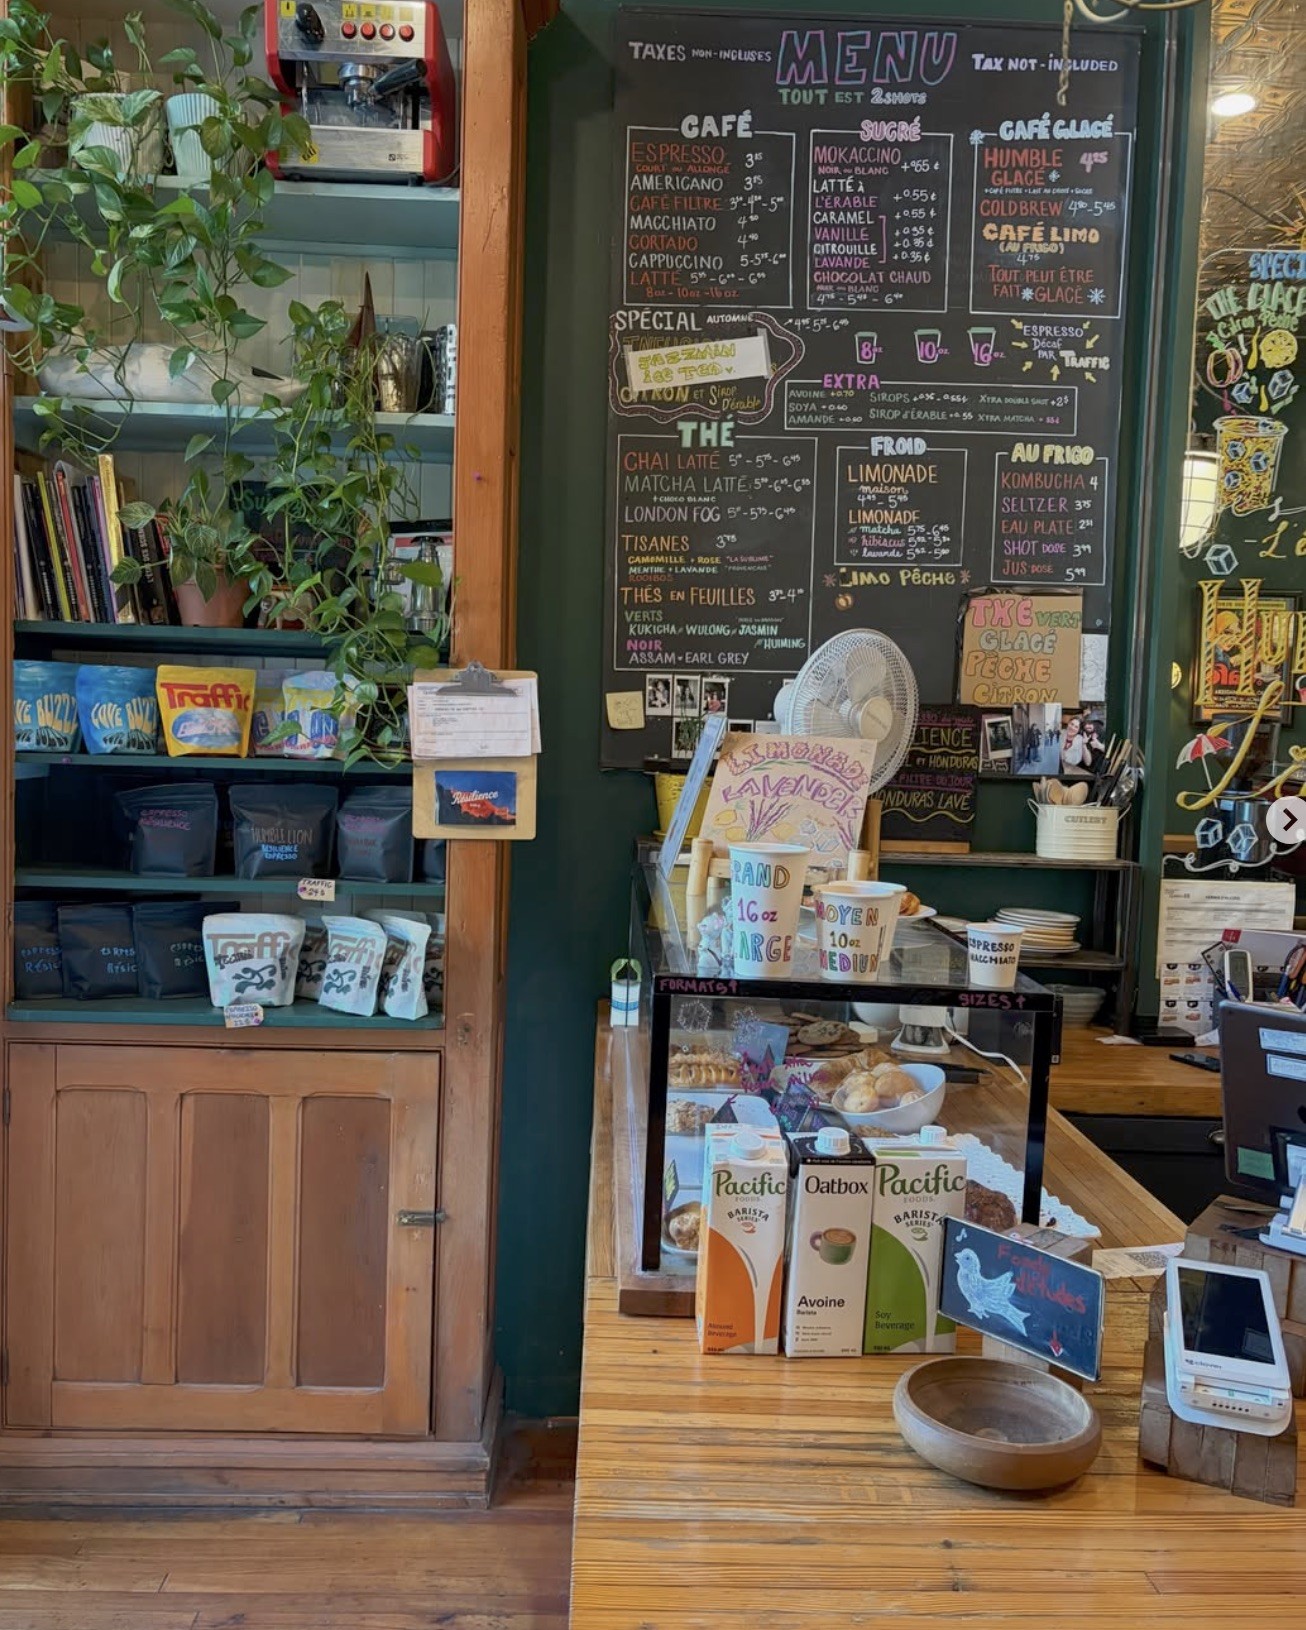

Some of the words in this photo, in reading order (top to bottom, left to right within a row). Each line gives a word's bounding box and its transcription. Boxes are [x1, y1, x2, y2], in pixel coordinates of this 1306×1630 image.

[629, 41, 686, 61] TAXES
[776, 30, 957, 85] MENU
[972, 53, 1003, 71] TAX
[778, 88, 828, 105] TOUT
[835, 91, 865, 103] EST
[680, 109, 752, 139] CAFÉ
[860, 115, 921, 142] SUCRÉ
[999, 112, 1050, 141] CAFÉ
[1052, 113, 1114, 140] GLACÉ
[631, 142, 725, 165] ESPRESSO
[814, 146, 901, 165] MOKACCINO
[984, 148, 1064, 169] HUMBLE
[630, 174, 724, 192] AMERICANO
[813, 176, 855, 193] LATTÉ
[991, 167, 1045, 187] GLACÉ
[630, 194, 669, 212] CAFÉ
[674, 197, 721, 211] FILTRE
[630, 215, 716, 231] MACCHIATO
[813, 211, 875, 225] CARAMEL
[814, 227, 869, 241] VANILLE
[982, 221, 1045, 241] CAFÉ
[1050, 226, 1100, 244] LIMO
[629, 233, 698, 251] CORTADO
[813, 243, 878, 255] CITROUILLE
[628, 253, 723, 270] CAPPUCCINO
[814, 256, 871, 269] LAVANDE
[813, 271, 884, 284] CHOCOLAT
[889, 271, 932, 284] CHAUD
[1026, 268, 1054, 283] PEUT
[993, 284, 1022, 298] FAIT
[1034, 285, 1084, 304] GLACÉ
[615, 307, 703, 331] SPÉCIAL
[1023, 325, 1084, 338] ESPRESSO
[823, 374, 881, 390] EXTRA
[788, 389, 826, 399] AVOINE
[870, 392, 910, 403] SIROPS
[788, 402, 817, 412] SOYA
[869, 408, 901, 420] SIROP
[788, 414, 836, 424] AMANDE
[677, 414, 735, 448] THÉ
[870, 436, 927, 457] FROID
[1011, 442, 1040, 463] AU
[1042, 444, 1095, 466] FRIGO
[624, 451, 669, 471] CHAI
[677, 451, 720, 470] LATTÉ
[847, 464, 938, 484] LIMONADE
[1001, 472, 1085, 490] KOMBUCHA
[624, 475, 696, 492] MATCHA
[859, 485, 909, 495] maison
[1001, 497, 1069, 513] SELTZER
[624, 506, 688, 523] LONDON
[693, 506, 721, 522] FOG
[848, 509, 921, 524] LIMONADE
[859, 525, 901, 536] matcha
[1001, 519, 1028, 534] EAU
[1033, 519, 1074, 535] PLATE
[621, 534, 690, 552] TISANES
[861, 536, 906, 548] hibiscus
[1003, 539, 1039, 556] SHOT
[628, 555, 686, 565] CAMOMILLE
[1002, 559, 1028, 575] JUS
[629, 566, 666, 575] MENTHE
[675, 566, 719, 575] LAVANDE
[620, 584, 663, 605] THÉS
[670, 590, 686, 601] EN
[690, 586, 756, 607] FEUILLES
[624, 610, 663, 623] VERTS
[1035, 611, 1082, 629] VERT
[629, 624, 677, 636] KUKICHA
[685, 624, 731, 636] WULONG
[738, 624, 779, 636] JASMIN
[626, 639, 663, 651] NOIR
[979, 628, 1058, 655] GLACÉ
[629, 652, 676, 665] ASSAM
[684, 652, 715, 664] EARL
[718, 652, 750, 665] GREY
[737, 897, 758, 923] 16
[830, 931, 848, 949] 10
[659, 978, 728, 995] FORMATS
[958, 993, 1012, 1011] SIZES
[712, 1169, 786, 1197] Pacific
[805, 1175, 869, 1195] Oatbox
[875, 1163, 967, 1197] Pacific
[727, 1207, 770, 1222] BARISTA
[894, 1209, 945, 1226] BARISTA
[797, 1295, 846, 1309] Avoine
[875, 1310, 892, 1320] Soy
